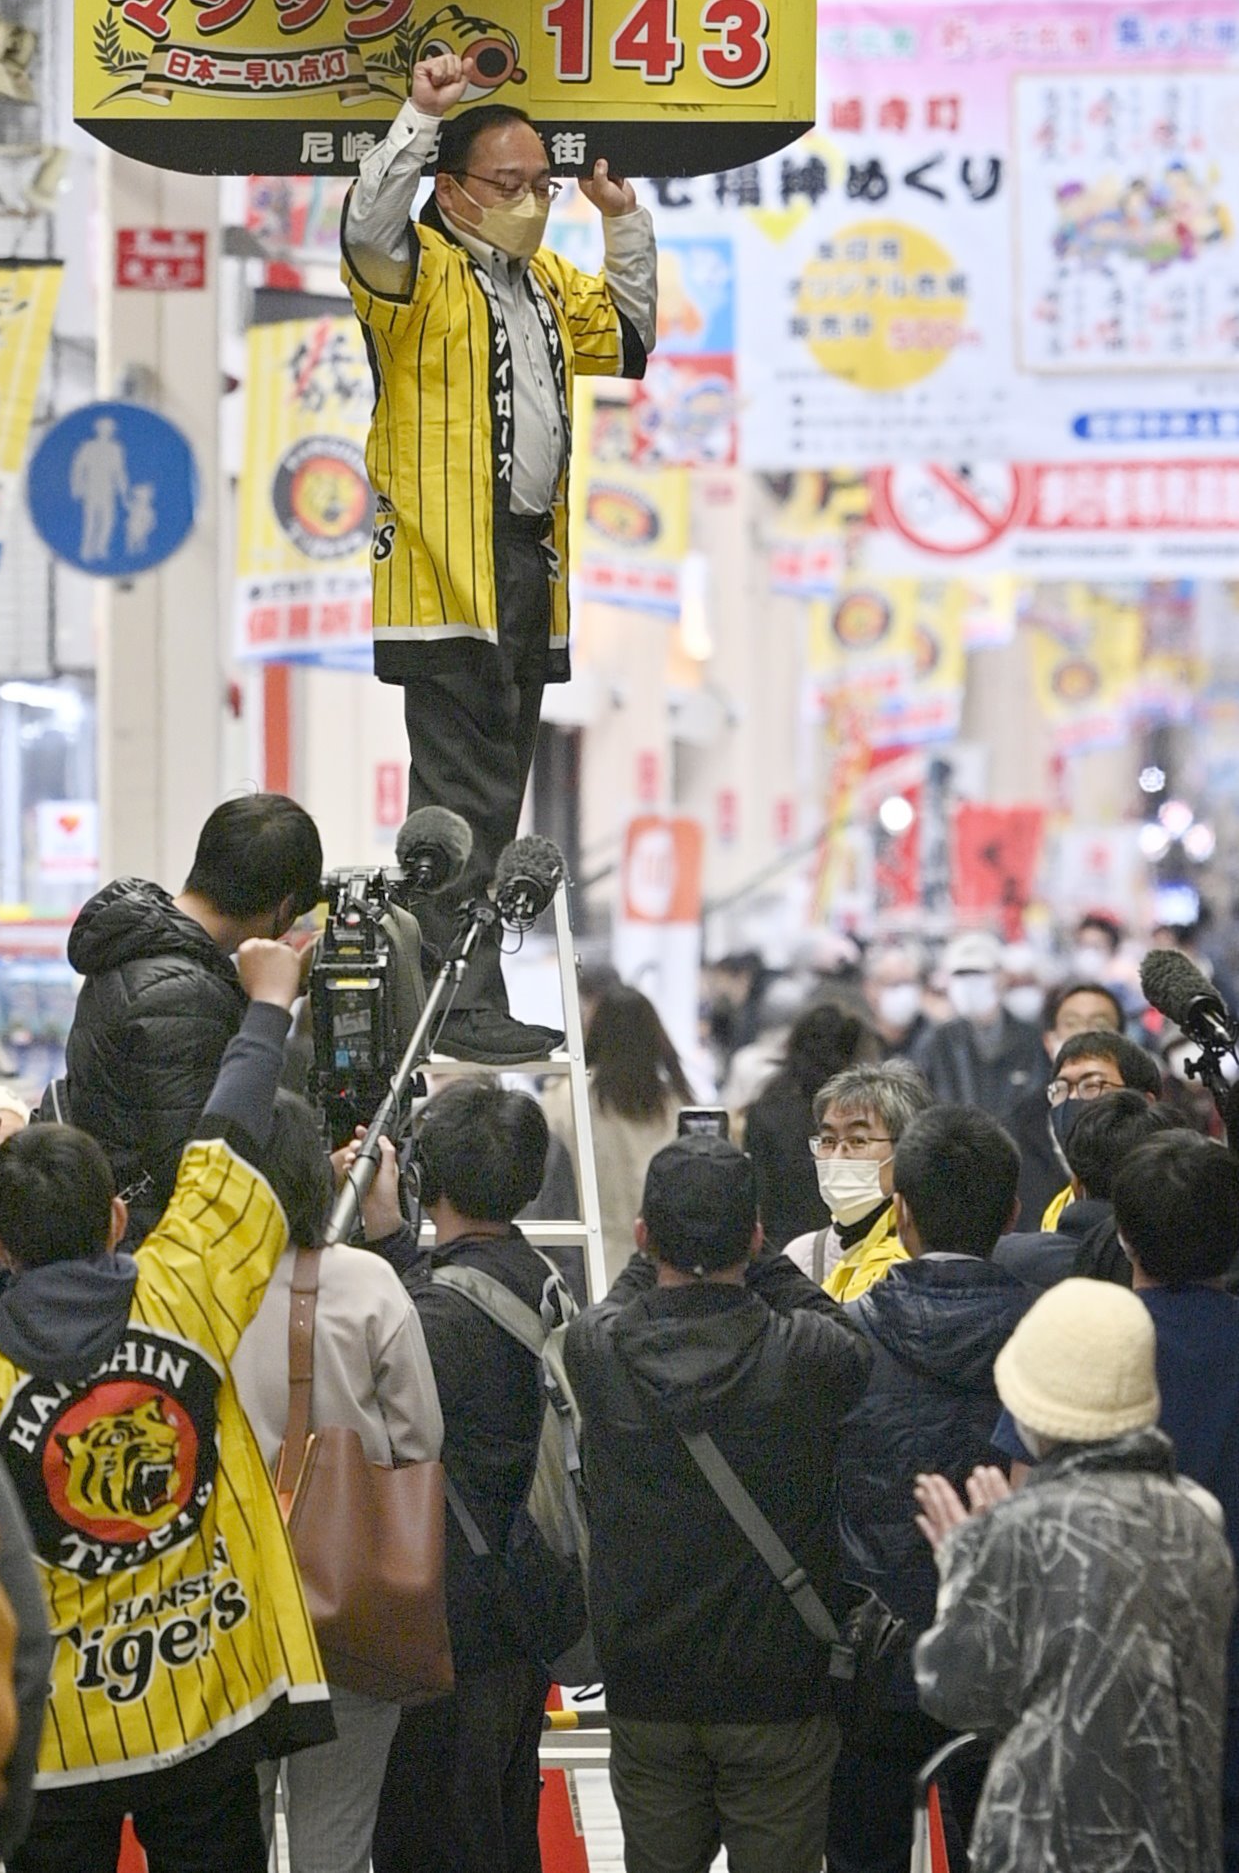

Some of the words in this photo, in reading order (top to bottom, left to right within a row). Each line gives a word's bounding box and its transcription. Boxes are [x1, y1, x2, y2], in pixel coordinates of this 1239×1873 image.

[165, 48, 349, 87] 日本一早い点灯
